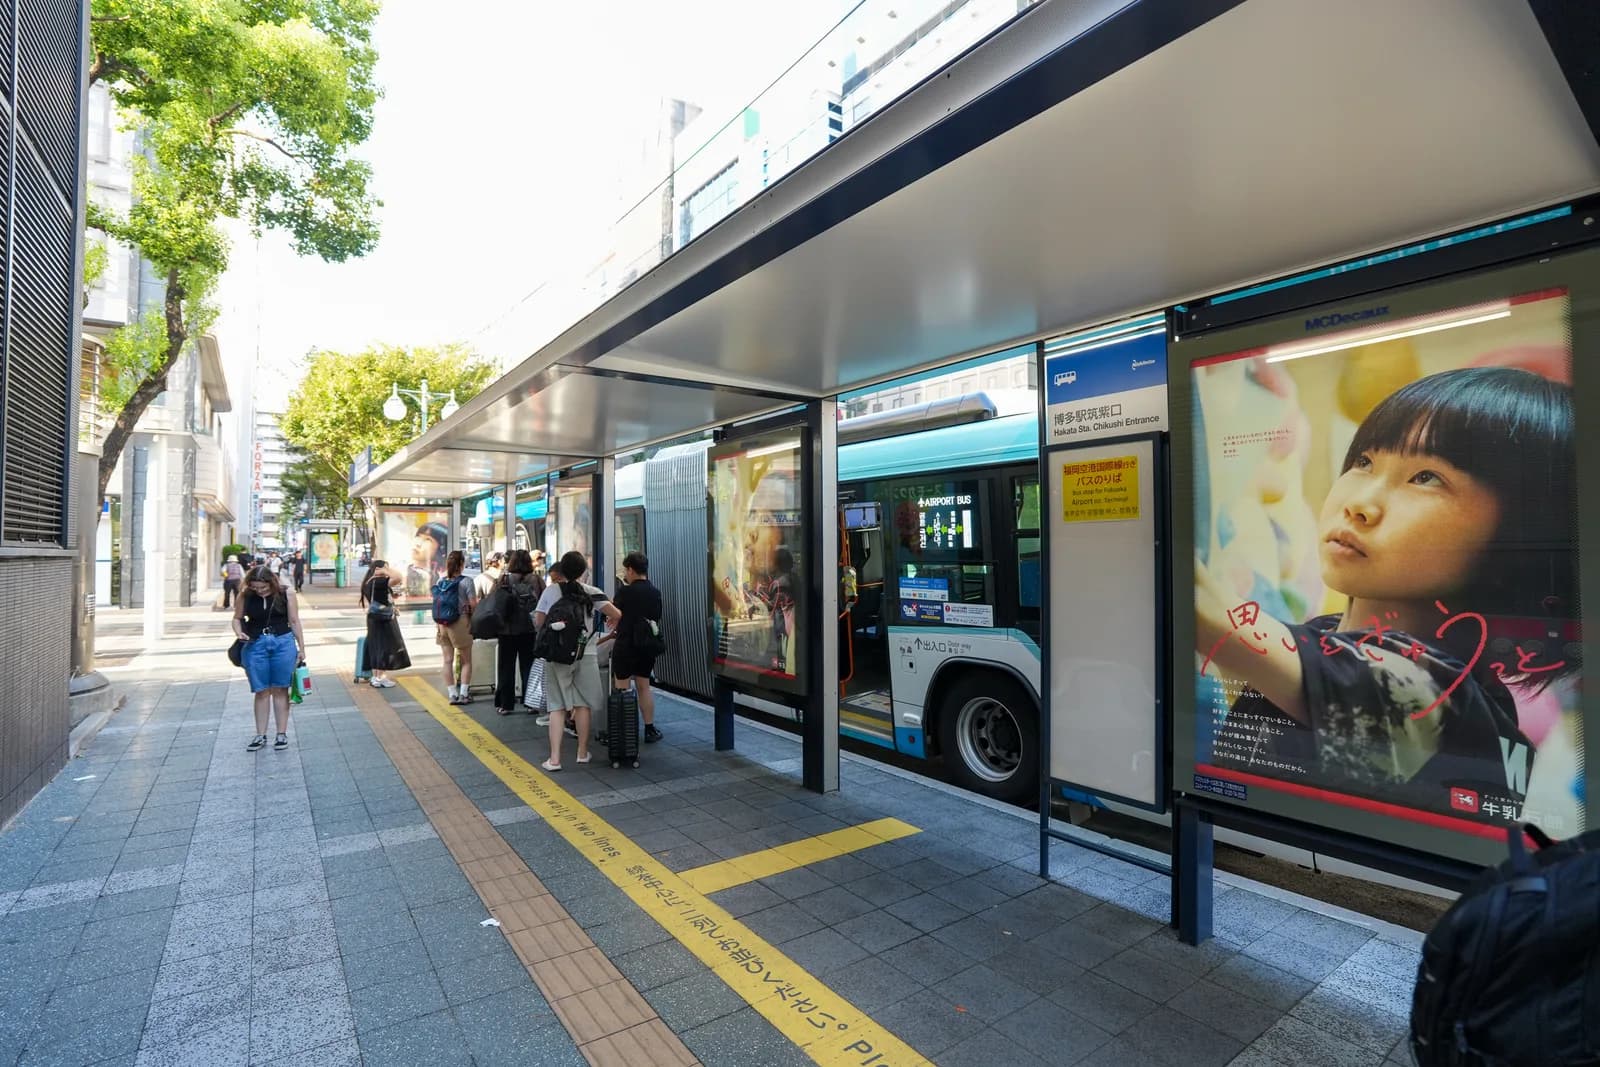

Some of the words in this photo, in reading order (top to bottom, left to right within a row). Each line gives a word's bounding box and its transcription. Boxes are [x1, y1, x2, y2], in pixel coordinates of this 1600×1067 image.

[1305, 306, 1390, 331] MCDecaux
[1054, 404, 1121, 426] 博多駅筑紫口
[1054, 427, 1077, 437] Hakata
[1078, 424, 1092, 433] Sta.
[1093, 419, 1124, 431] Chikushi
[1125, 415, 1160, 427] Entrance
[254, 442, 262, 491] FORZA
[1077, 472, 1122, 486] バスのりば
[925, 496, 955, 507] AIRPORT
[957, 495, 972, 505] BUS
[1072, 498, 1094, 506] Airport
[923, 640, 947, 653] 出入口
[572, 822, 596, 837] two
[592, 836, 621, 858] lines
[843, 1040, 890, 1067] Pl
